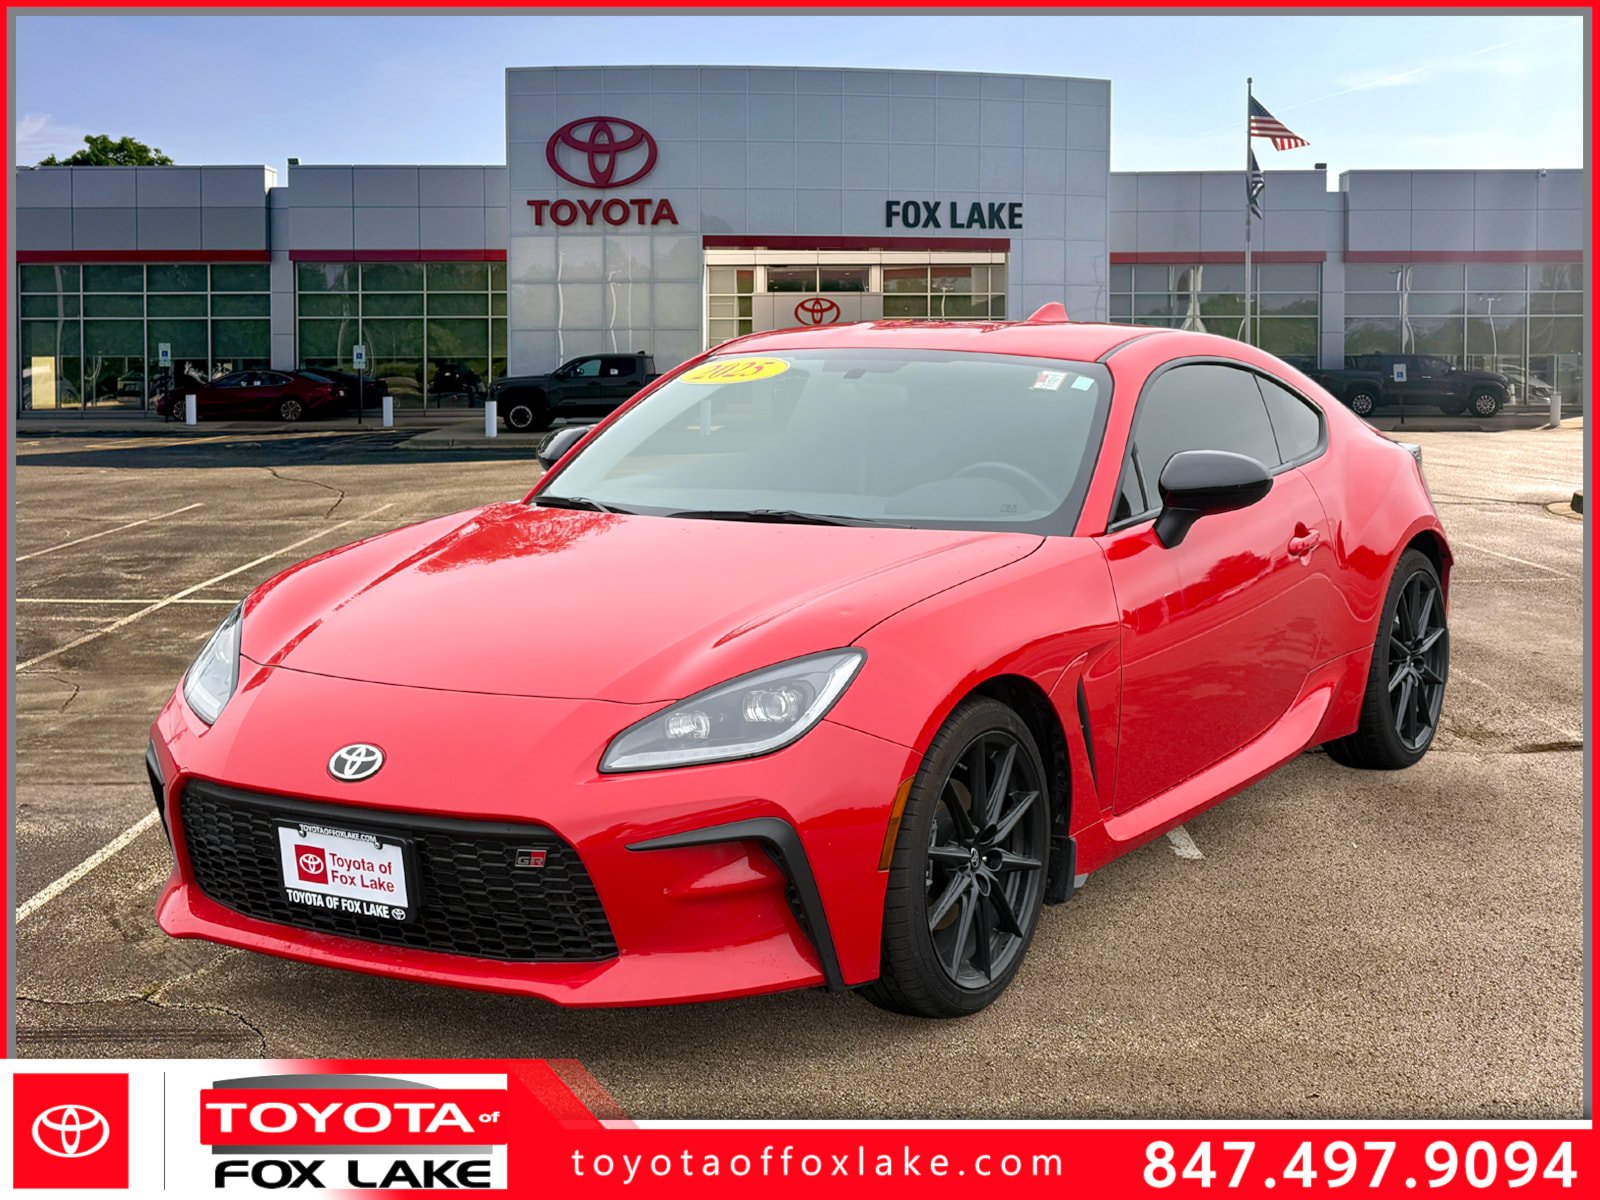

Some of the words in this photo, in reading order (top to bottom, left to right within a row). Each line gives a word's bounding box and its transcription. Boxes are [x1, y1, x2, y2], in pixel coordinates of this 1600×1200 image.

[527, 198, 679, 226] TOYOTA
[885, 200, 942, 228] FOX
[949, 201, 1023, 229] LAKE
[690, 361, 776, 379] 2025
[298, 823, 377, 843] TOYOTAOFFOXLAKE.COM
[329, 852, 375, 873] Toyota
[378, 861, 393, 875] of
[517, 856, 545, 865] GR
[330, 870, 357, 887] Fox
[360, 874, 395, 893] Lake
[286, 889, 325, 908] TOYOTA
[325, 896, 340, 910] OF
[341, 898, 362, 914] FOX
[363, 902, 390, 919] LAKE
